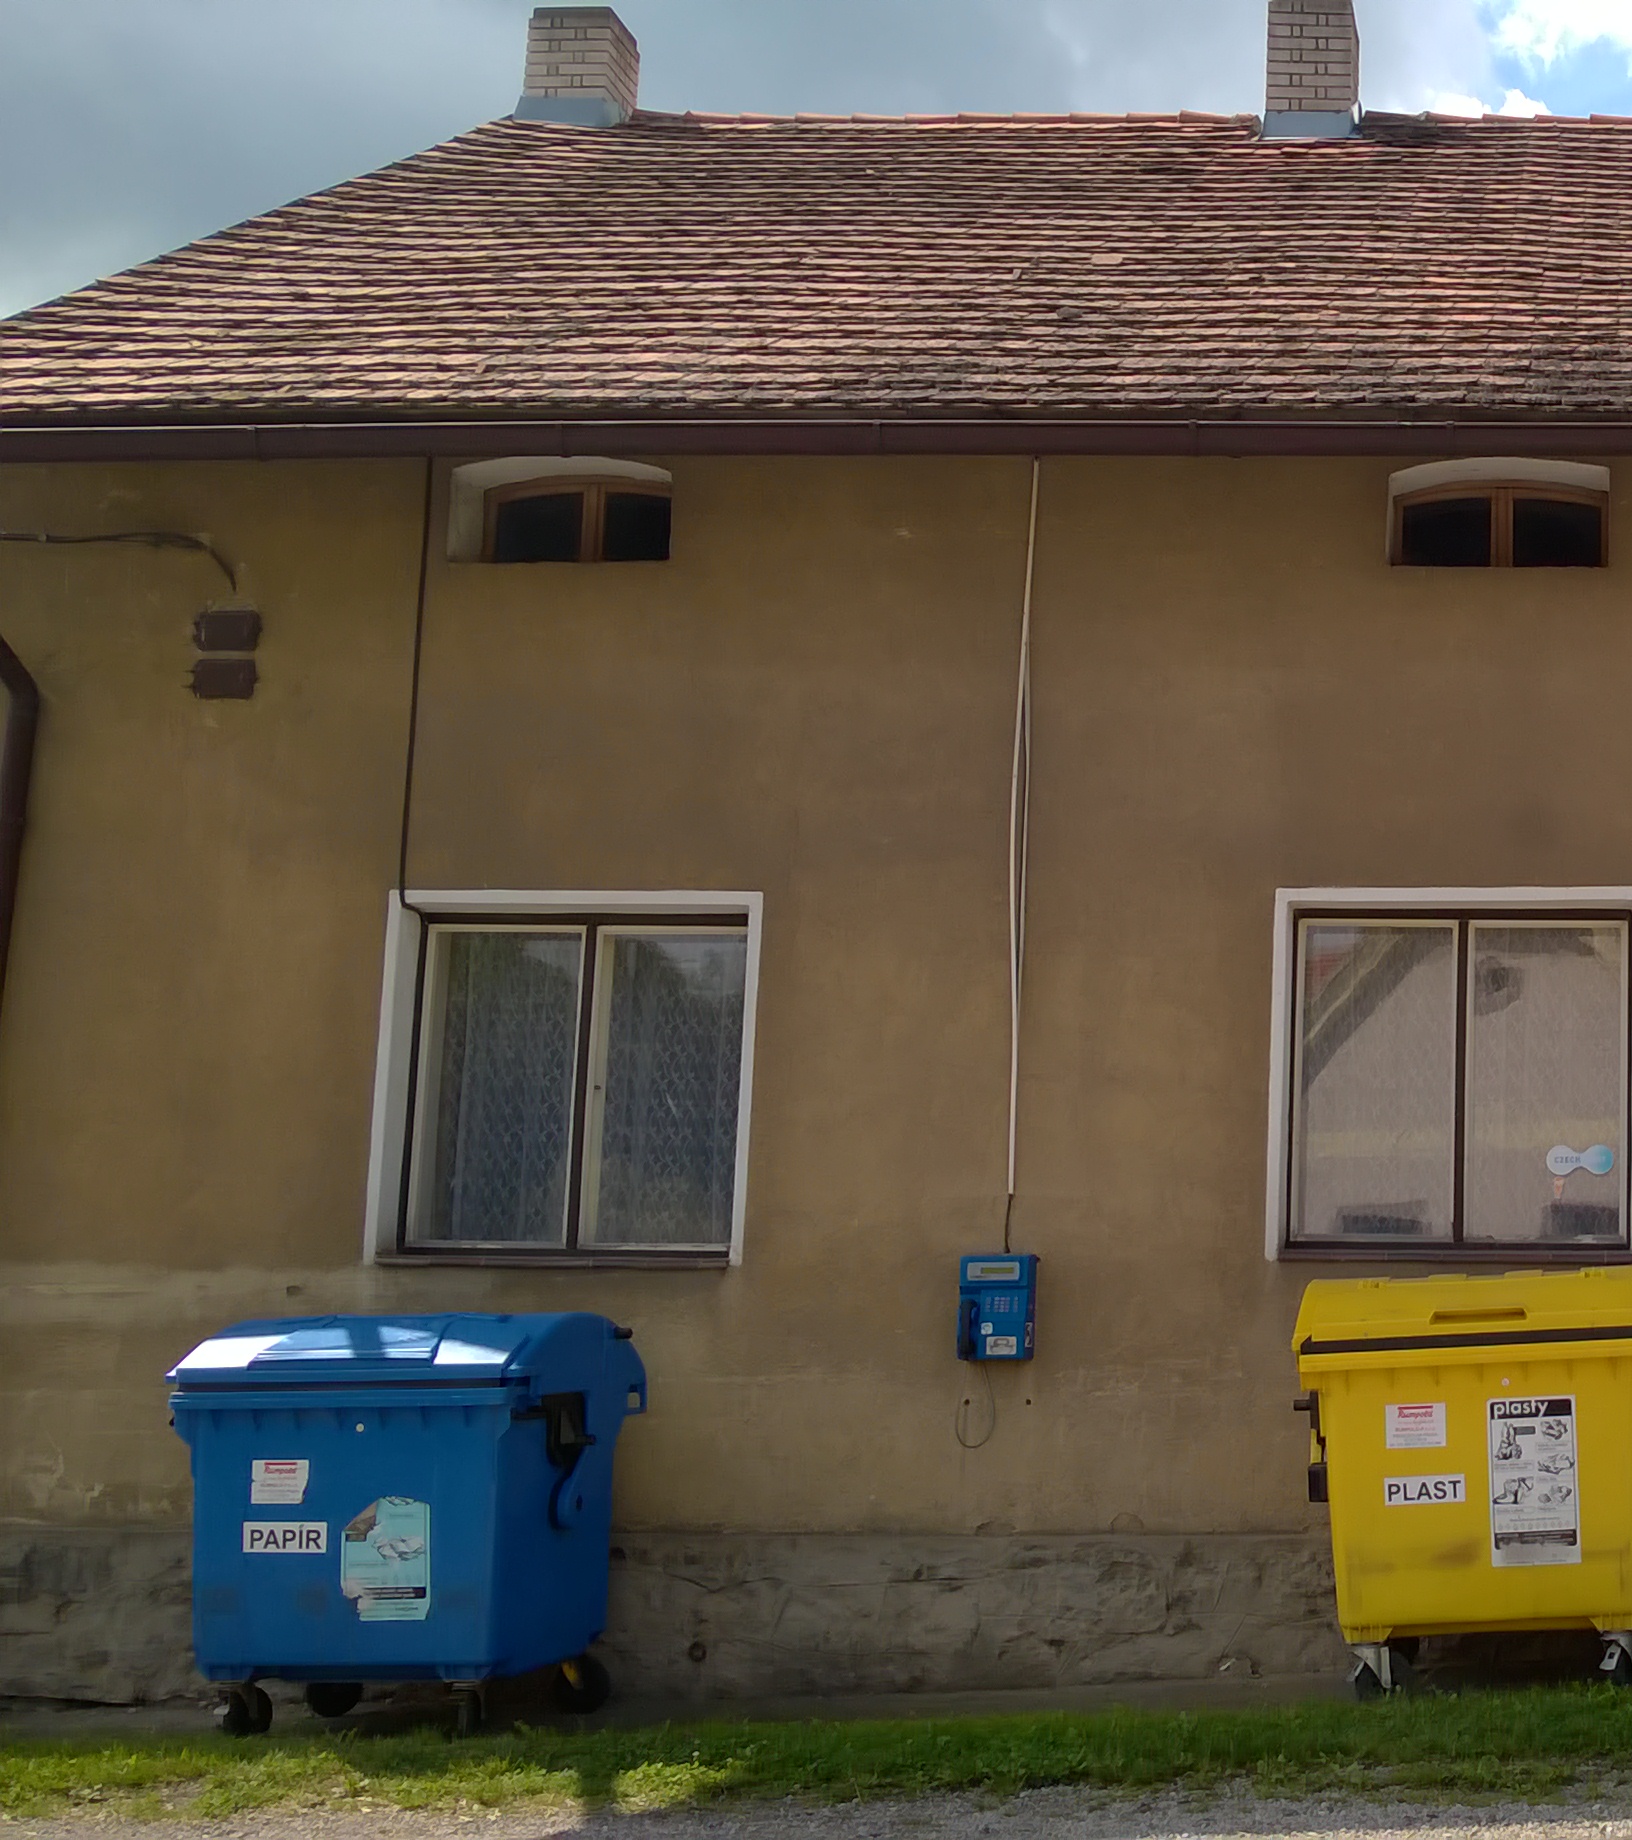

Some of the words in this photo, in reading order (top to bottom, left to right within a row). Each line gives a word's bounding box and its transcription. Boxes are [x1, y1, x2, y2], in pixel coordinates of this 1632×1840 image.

[1554, 1155, 1581, 1164] CZECH
[1493, 1400, 1549, 1419] plasty
[1387, 1480, 1461, 1502] PLAST
[249, 1524, 322, 1549] PAPÍR
